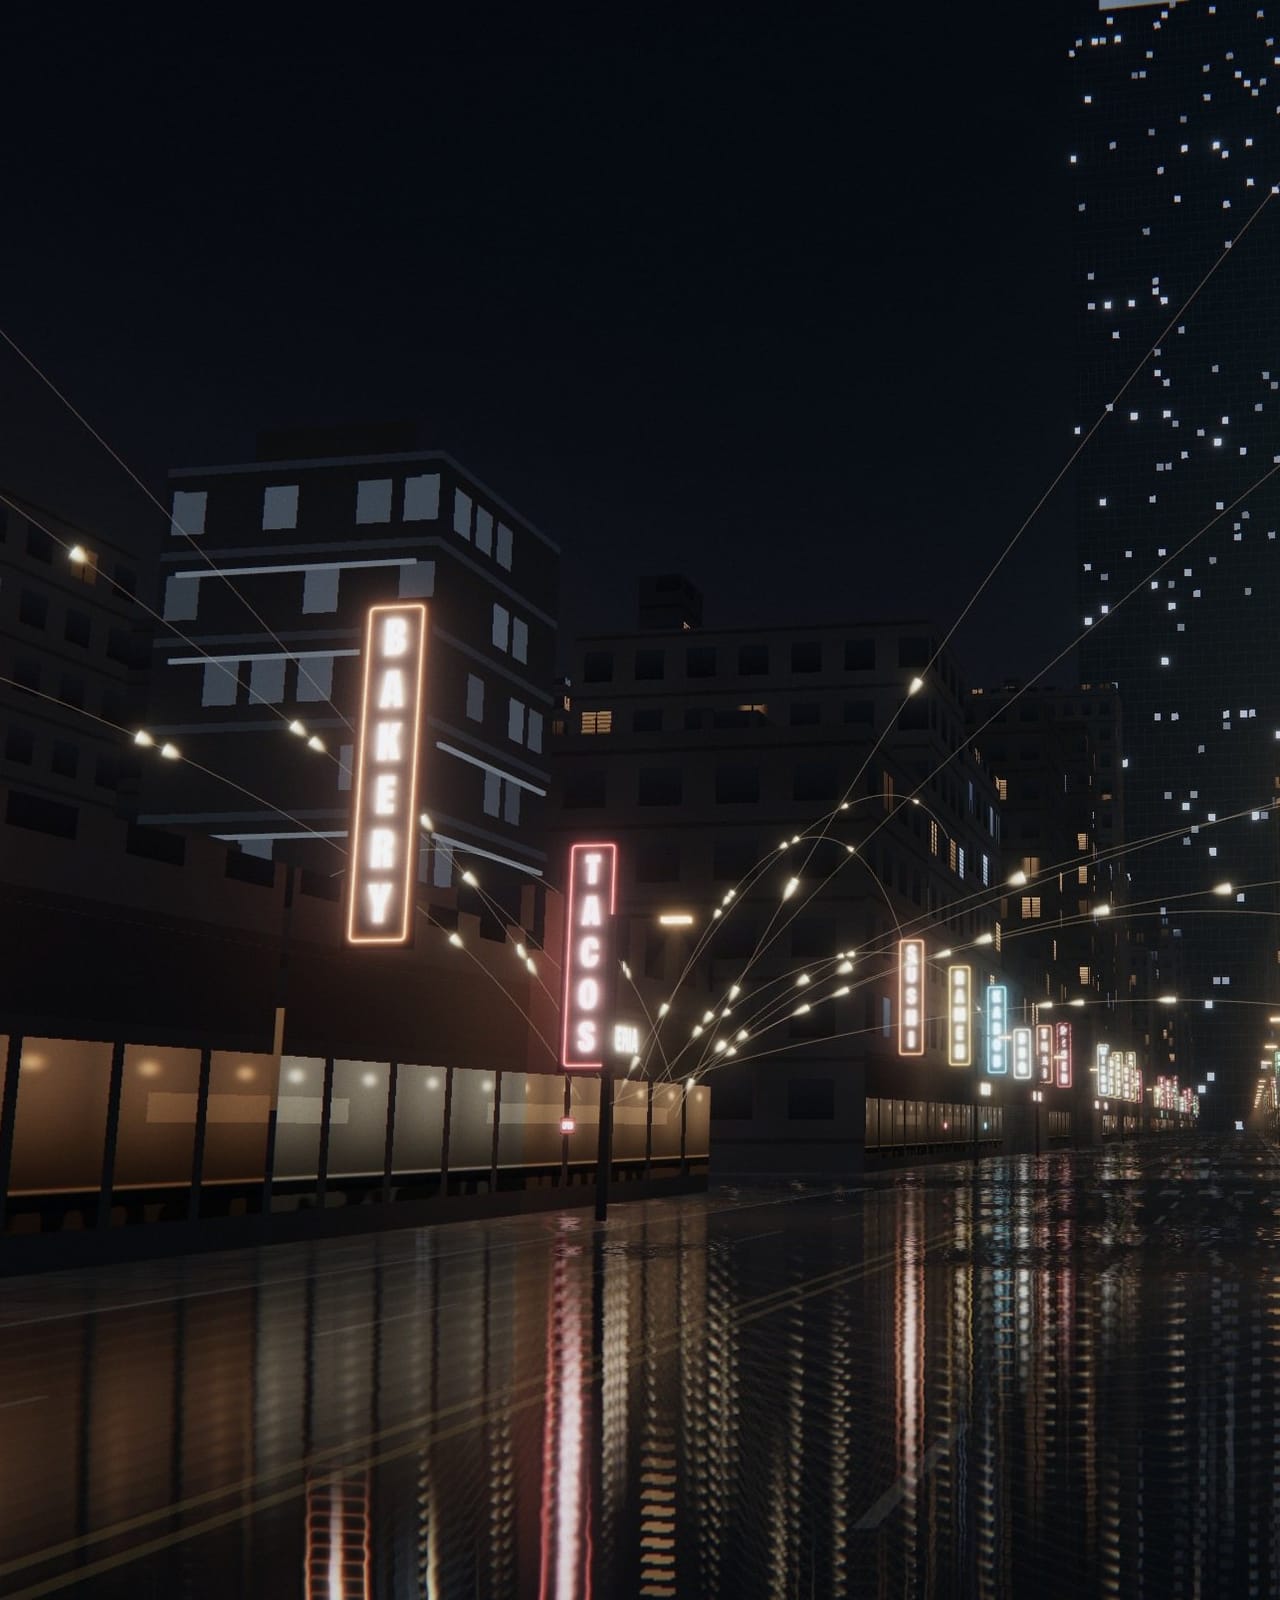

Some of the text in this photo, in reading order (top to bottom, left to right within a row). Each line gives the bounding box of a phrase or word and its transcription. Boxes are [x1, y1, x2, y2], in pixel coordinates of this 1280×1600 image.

[368, 618, 408, 925] BAKERY
[577, 854, 602, 1053] TACOS
[904, 944, 918, 1048] SUSHI
[953, 970, 966, 1060] RAMEN
